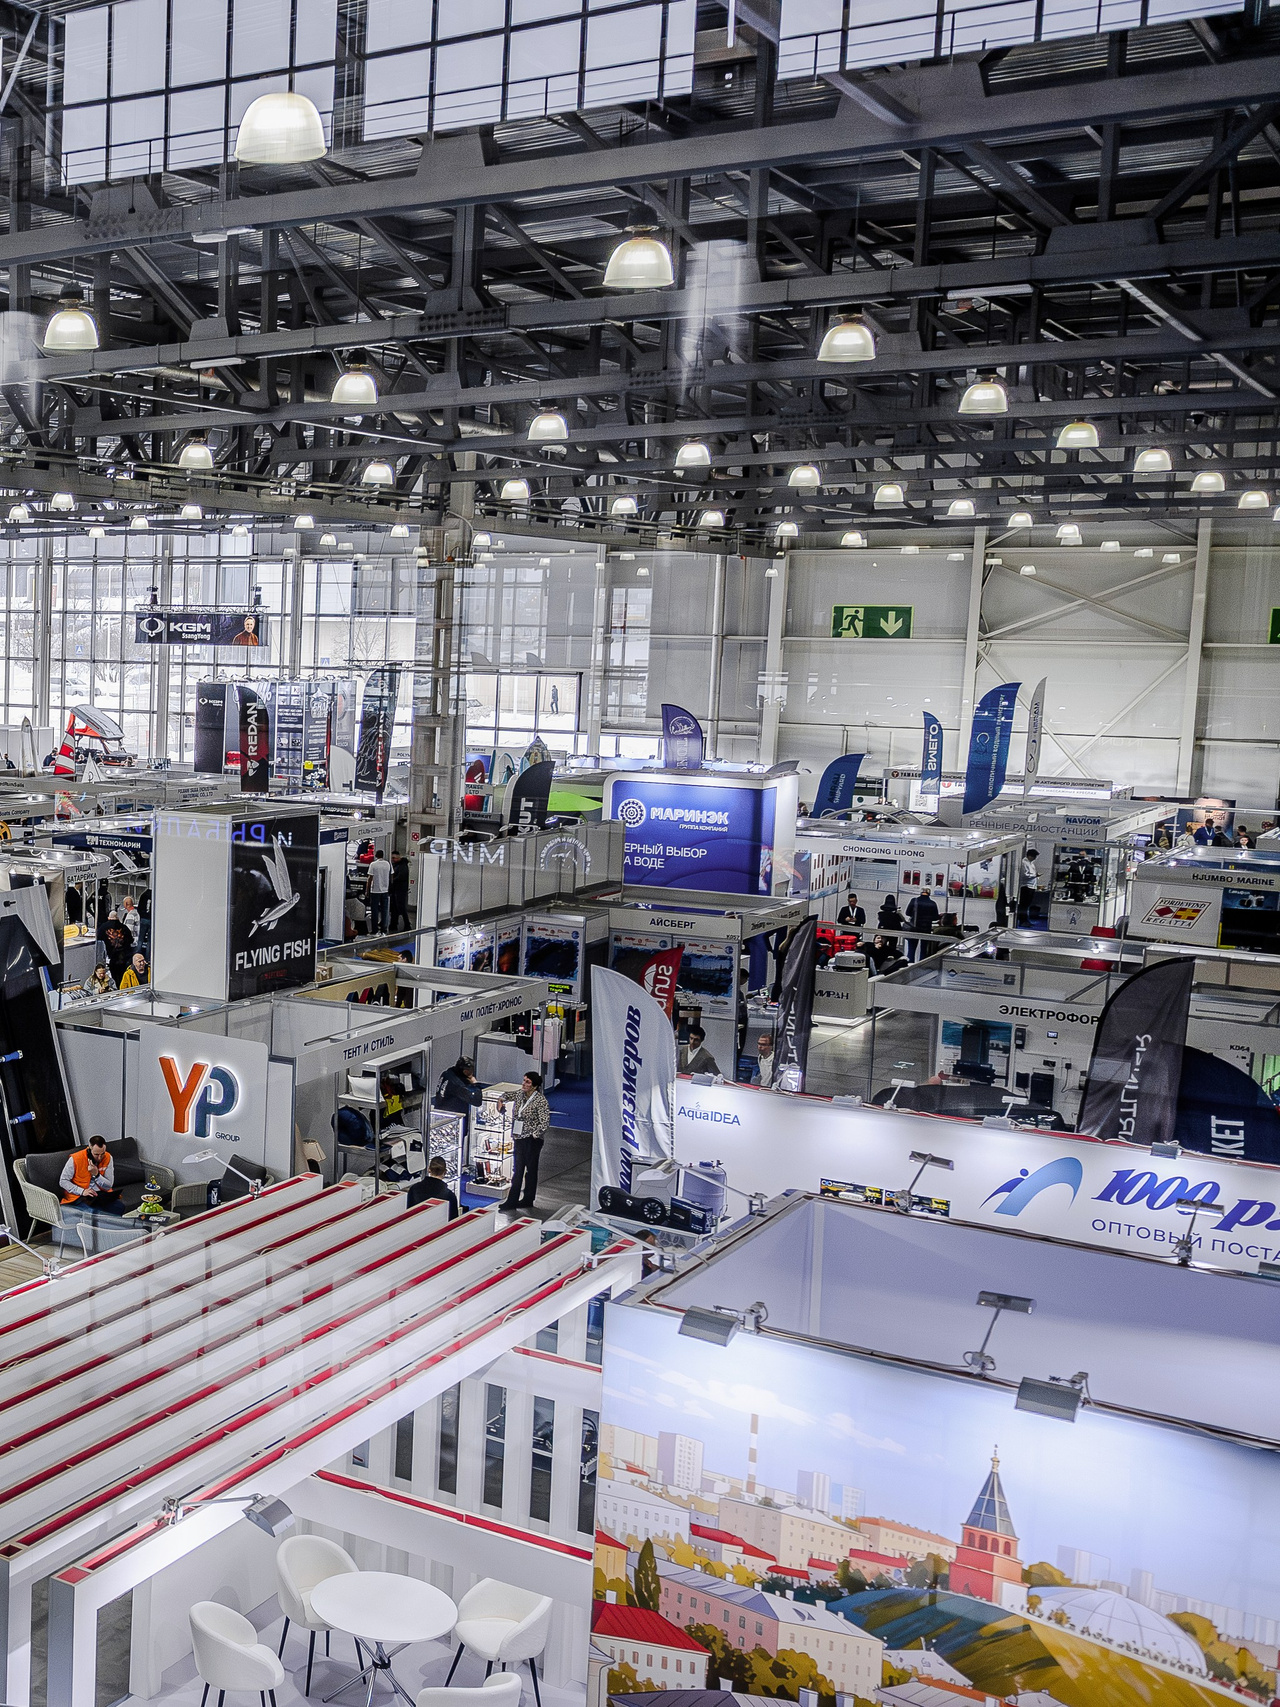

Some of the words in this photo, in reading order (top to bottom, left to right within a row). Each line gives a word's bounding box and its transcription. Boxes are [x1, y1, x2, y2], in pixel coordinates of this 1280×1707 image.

[169, 623, 211, 632] KGM
[181, 633, 211, 641] SsangYong
[246, 702, 258, 756] REDAN
[11, 808, 30, 817] Company
[650, 807, 729, 825] МАРИНЭК
[1065, 816, 1101, 826] NAVIOM
[970, 820, 1010, 831] РЕЧНЫЕ
[1013, 823, 1099, 837] РАДИОСТАНЦИИ
[99, 839, 141, 849] ТЕХНОМАРИН
[624, 843, 663, 856] ЕРНЫЙ
[666, 846, 707, 858] ВЫБОР
[843, 845, 891, 855] CHONGQING
[894, 848, 925, 858] LIDONG
[634, 856, 665, 868] ВОДЕ
[76, 864, 91, 873] НАША
[67, 872, 97, 883] БАТАРЕЙКА
[1192, 873, 1233, 883] HJUMBO
[1237, 876, 1275, 886] MARINE
[1158, 899, 1206, 909] FORDEWIND
[649, 917, 696, 930] АЙСБЕРГ
[1145, 916, 1192, 928] REGATTA
[235, 943, 281, 971] FLYING
[283, 938, 311, 961] FISH
[813, 989, 849, 1000] МИРАН
[998, 1004, 1100, 1025] ЭЛЕКТРОФОР
[343, 1046, 361, 1060] ТЕНТ
[363, 1044, 369, 1054] И
[371, 1034, 395, 1051] СТИЛЬ
[621, 1005, 643, 1151] размеров
[677, 1105, 741, 1127] AquaIDEA
[215, 1131, 240, 1143] GROUP
